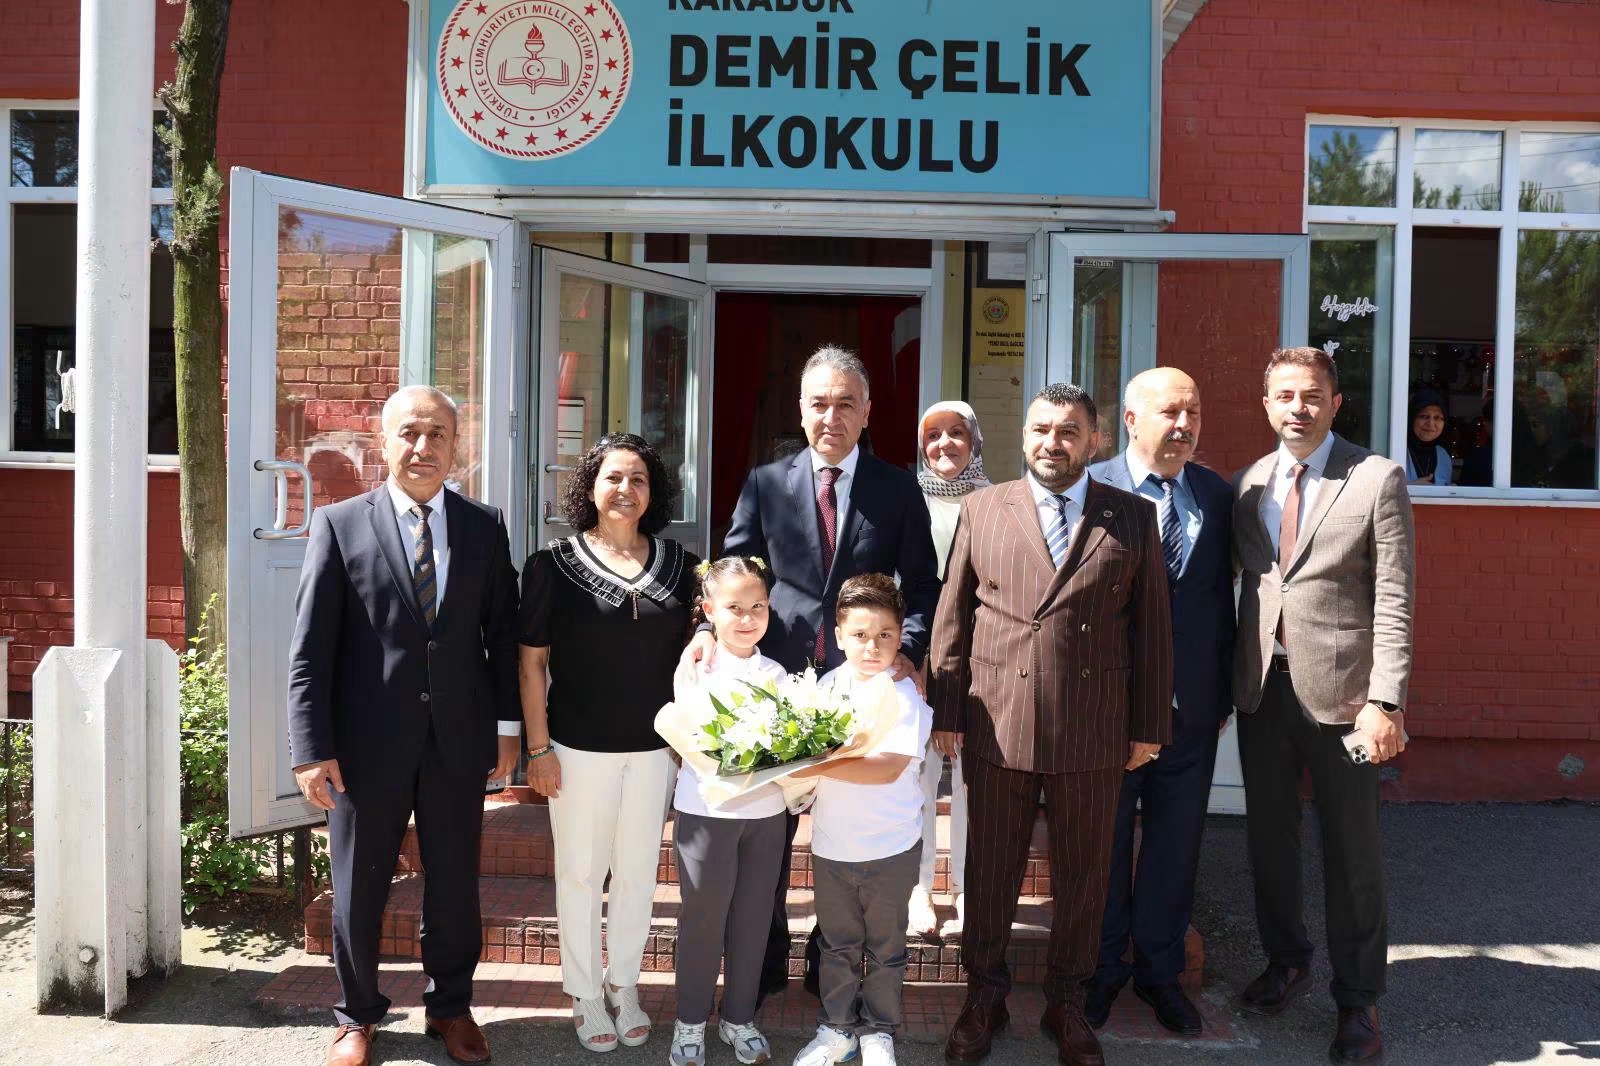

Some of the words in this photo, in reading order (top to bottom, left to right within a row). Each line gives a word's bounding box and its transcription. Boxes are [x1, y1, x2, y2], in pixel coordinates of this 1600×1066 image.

[475, 4, 527, 75] CUMHURİYETİ
[532, 4, 568, 20] MİLLİ
[567, 18, 594, 59] EĞİTİM
[669, 22, 878, 91] DEMİR
[898, 27, 1092, 99] ÇELİK
[478, 80, 519, 119] TÜRKİYE
[547, 64, 594, 119] BAKANLIĞI
[667, 98, 999, 173] İLKOKULU
